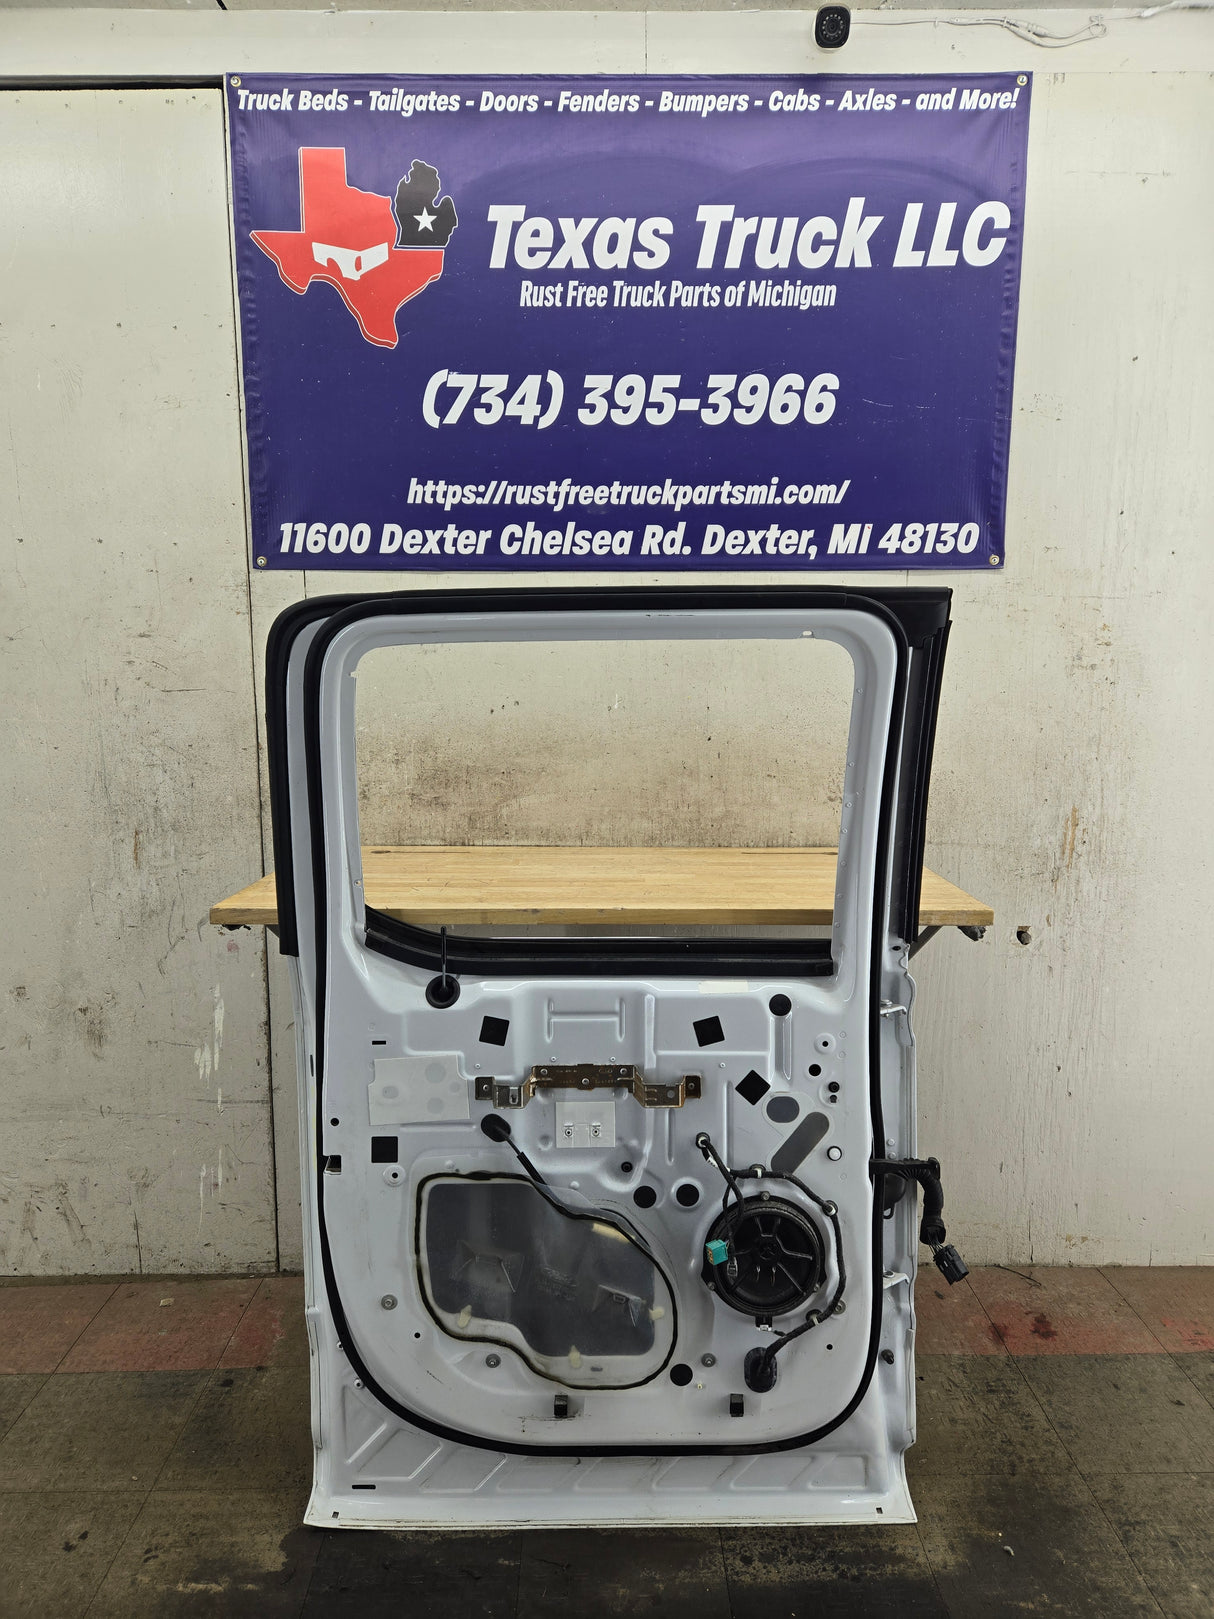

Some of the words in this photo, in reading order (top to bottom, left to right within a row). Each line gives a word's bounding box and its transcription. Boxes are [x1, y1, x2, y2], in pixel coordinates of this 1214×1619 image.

[237, 87, 295, 112] Truck
[297, 88, 350, 112] Beds
[368, 87, 461, 118] Tailgates
[479, 90, 540, 113] Doors
[557, 88, 641, 113] Fenders
[658, 90, 750, 119] Bumpers
[768, 88, 822, 112] Cabs
[837, 87, 898, 113] Axles
[915, 86, 958, 112] and
[958, 87, 1021, 112] More!
[486, 204, 674, 270] Texas
[695, 196, 885, 270] Truck
[892, 200, 1012, 268] LLC
[519, 280, 564, 308] Rust
[566, 280, 609, 308] Free
[612, 280, 667, 308] Truck
[668, 280, 722, 308] Parts
[723, 280, 747, 308] of
[746, 279, 837, 311] Michigan
[422, 368, 564, 430] (734)
[577, 372, 840, 426] 395-3966
[406, 476, 852, 512] https://rustfreetruckpartsmi.com/
[279, 522, 372, 554] 11600
[379, 523, 493, 555] Dexter
[499, 521, 634, 556] Chelsea
[640, 521, 692, 556] Rd.
[700, 523, 818, 560] Dexter,
[826, 523, 874, 555] MI
[877, 522, 980, 554] 48130
